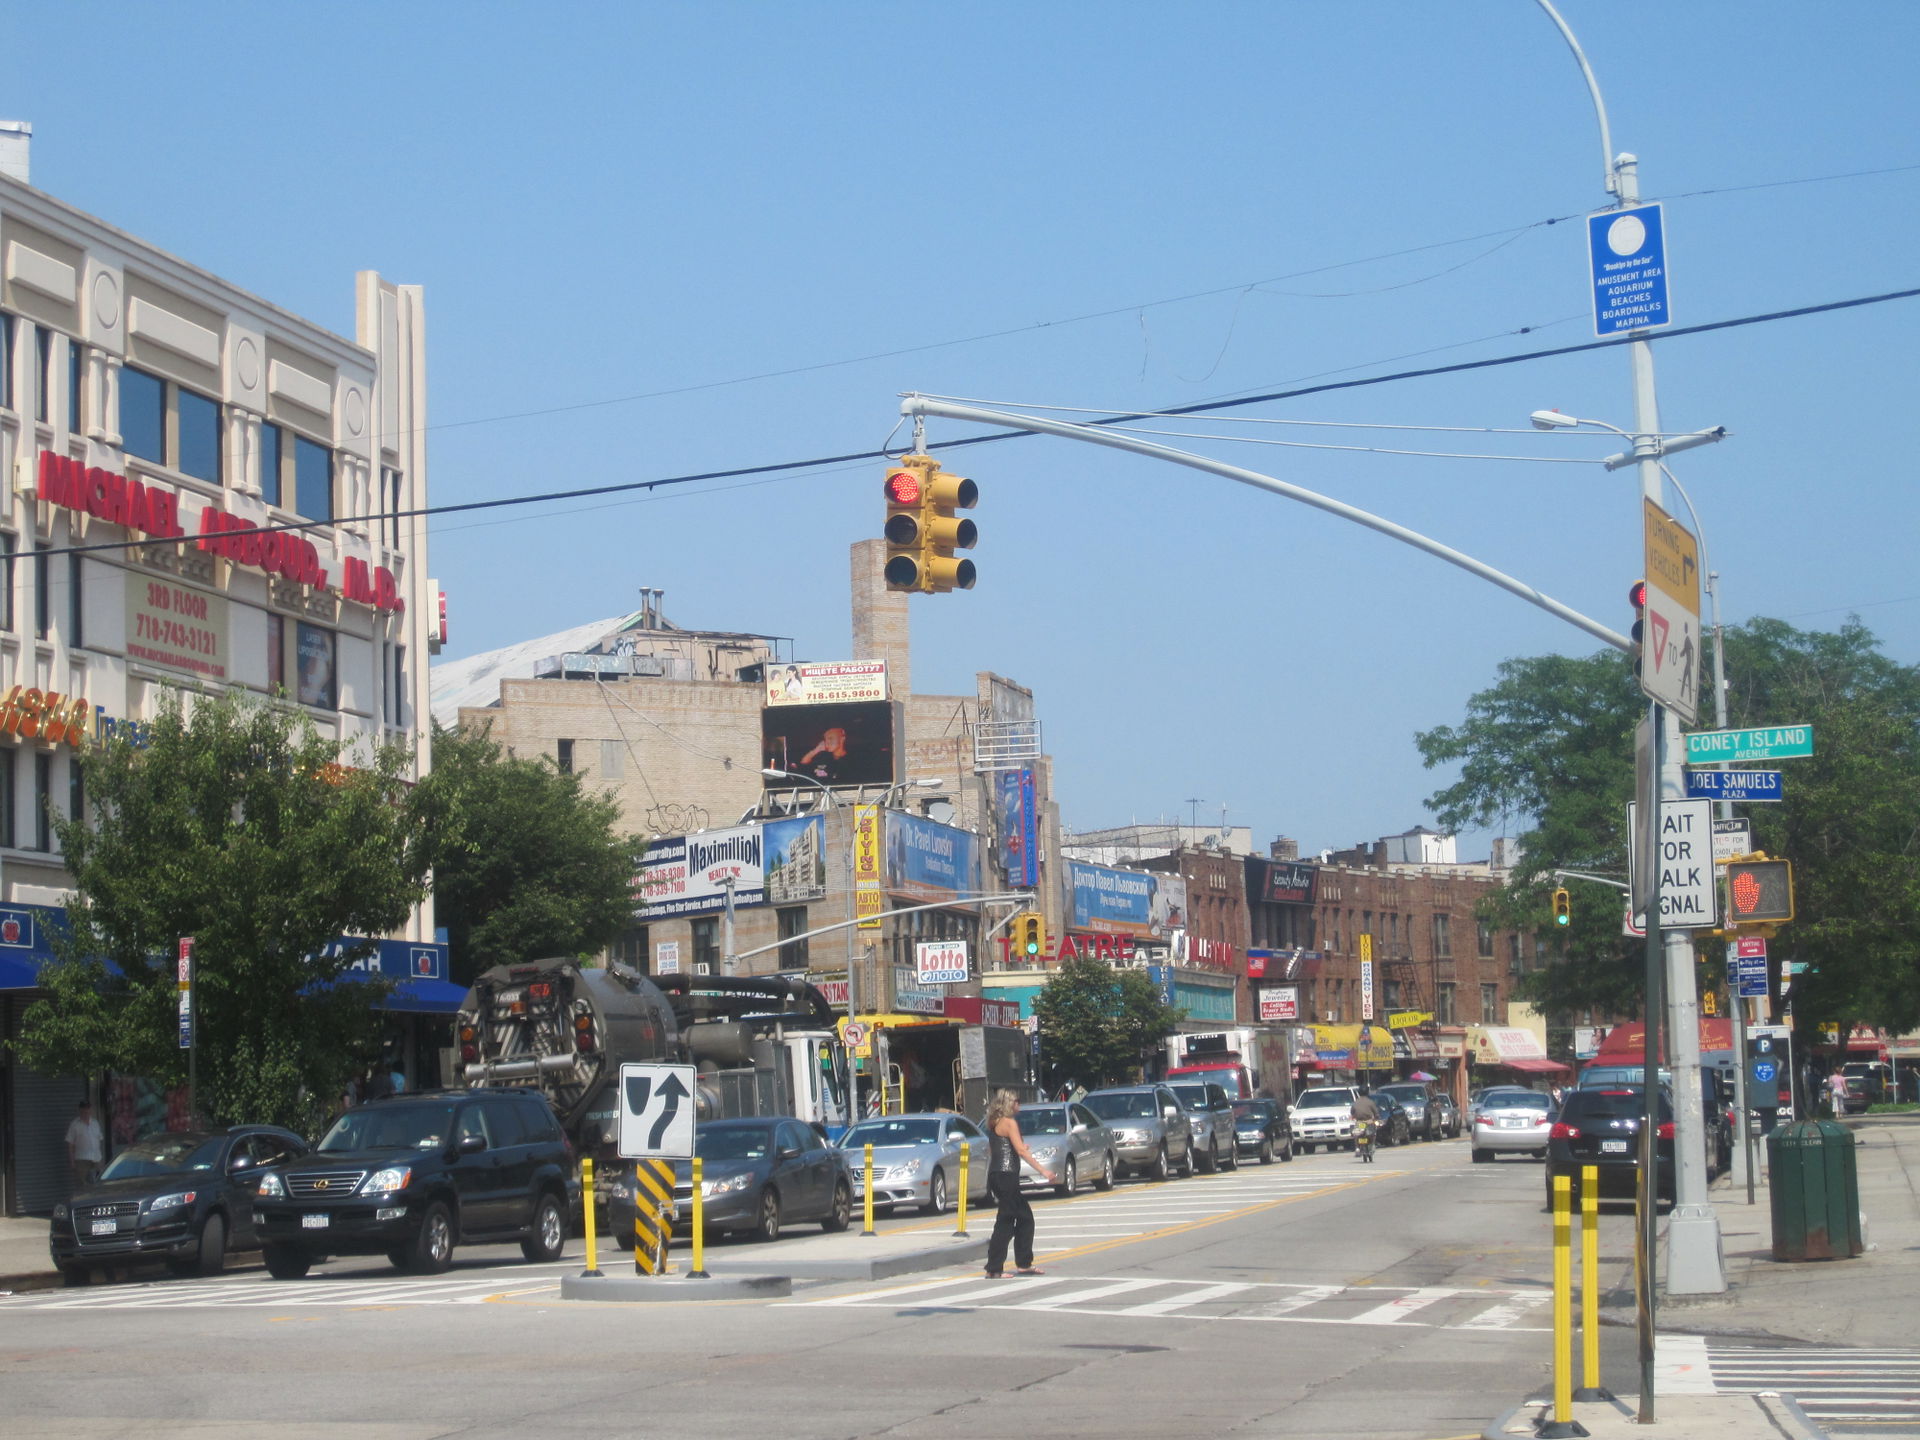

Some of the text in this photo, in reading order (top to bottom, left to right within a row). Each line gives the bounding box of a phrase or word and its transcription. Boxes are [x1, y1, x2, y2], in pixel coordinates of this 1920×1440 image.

[1597, 268, 1662, 286] AMUSEMENT AREA
[1608, 281, 1653, 296] AQUARIUM
[1611, 292, 1651, 307] BEACHES
[1602, 302, 1661, 319] BOARDWALKS
[1615, 316, 1649, 328] MARINA
[37, 449, 185, 539] MICHAEL
[343, 555, 406, 612] M.D.
[1648, 512, 1680, 555] TURNING
[1648, 545, 1680, 586] VEHICLES
[147, 582, 208, 621] 3RD FLOOR
[136, 613, 216, 656] 718-743-3121
[1668, 642, 1677, 666] TO
[805, 665, 880, 677] ИЩЕТЕ РАБОТУ?
[806, 690, 880, 700] 718.615.9800
[1690, 729, 1805, 753] CONEY ISLAND
[1734, 748, 1770, 758] AVENUE
[1689, 772, 1776, 789] JOEL SAMUELS
[1722, 790, 1746, 798] PLAZA
[1660, 814, 1694, 834] AIT
[860, 818, 873, 871] DRIVING
[905, 824, 953, 862] Dr. Pavel Lvovsky
[1660, 842, 1692, 861] OR
[708, 867, 728, 881] REALTY
[1074, 867, 1095, 891] Доктор
[1096, 870, 1114, 891] Павел
[1659, 868, 1701, 888] ALK
[858, 892, 879, 904] АВТО
[1659, 895, 1705, 915] GNAL
[997, 933, 1135, 963] TEATRE
[921, 947, 964, 971] Lotto
[932, 970, 963, 981] ЛОТО
[1392, 1015, 1418, 1027] LIQUOR
[1761, 1040, 1769, 1053] P
